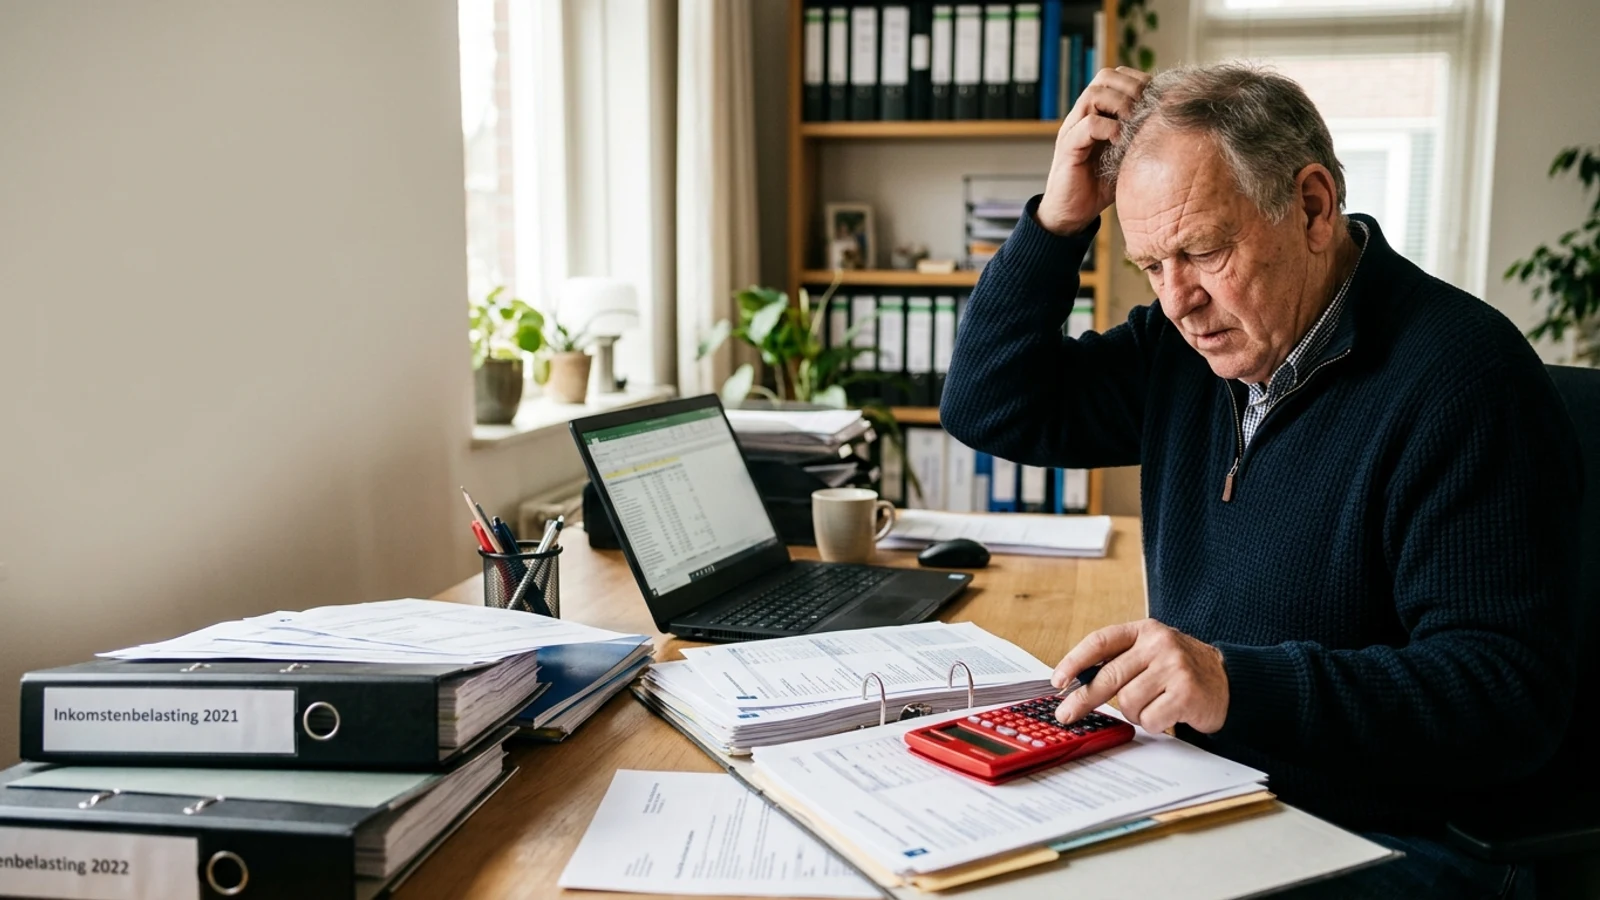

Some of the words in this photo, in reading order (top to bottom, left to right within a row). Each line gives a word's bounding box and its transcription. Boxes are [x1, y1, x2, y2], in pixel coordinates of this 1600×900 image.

[53, 707, 199, 726] Inkomstenbelasting
[203, 708, 238, 722] 2021
[91, 858, 129, 875] 2022
